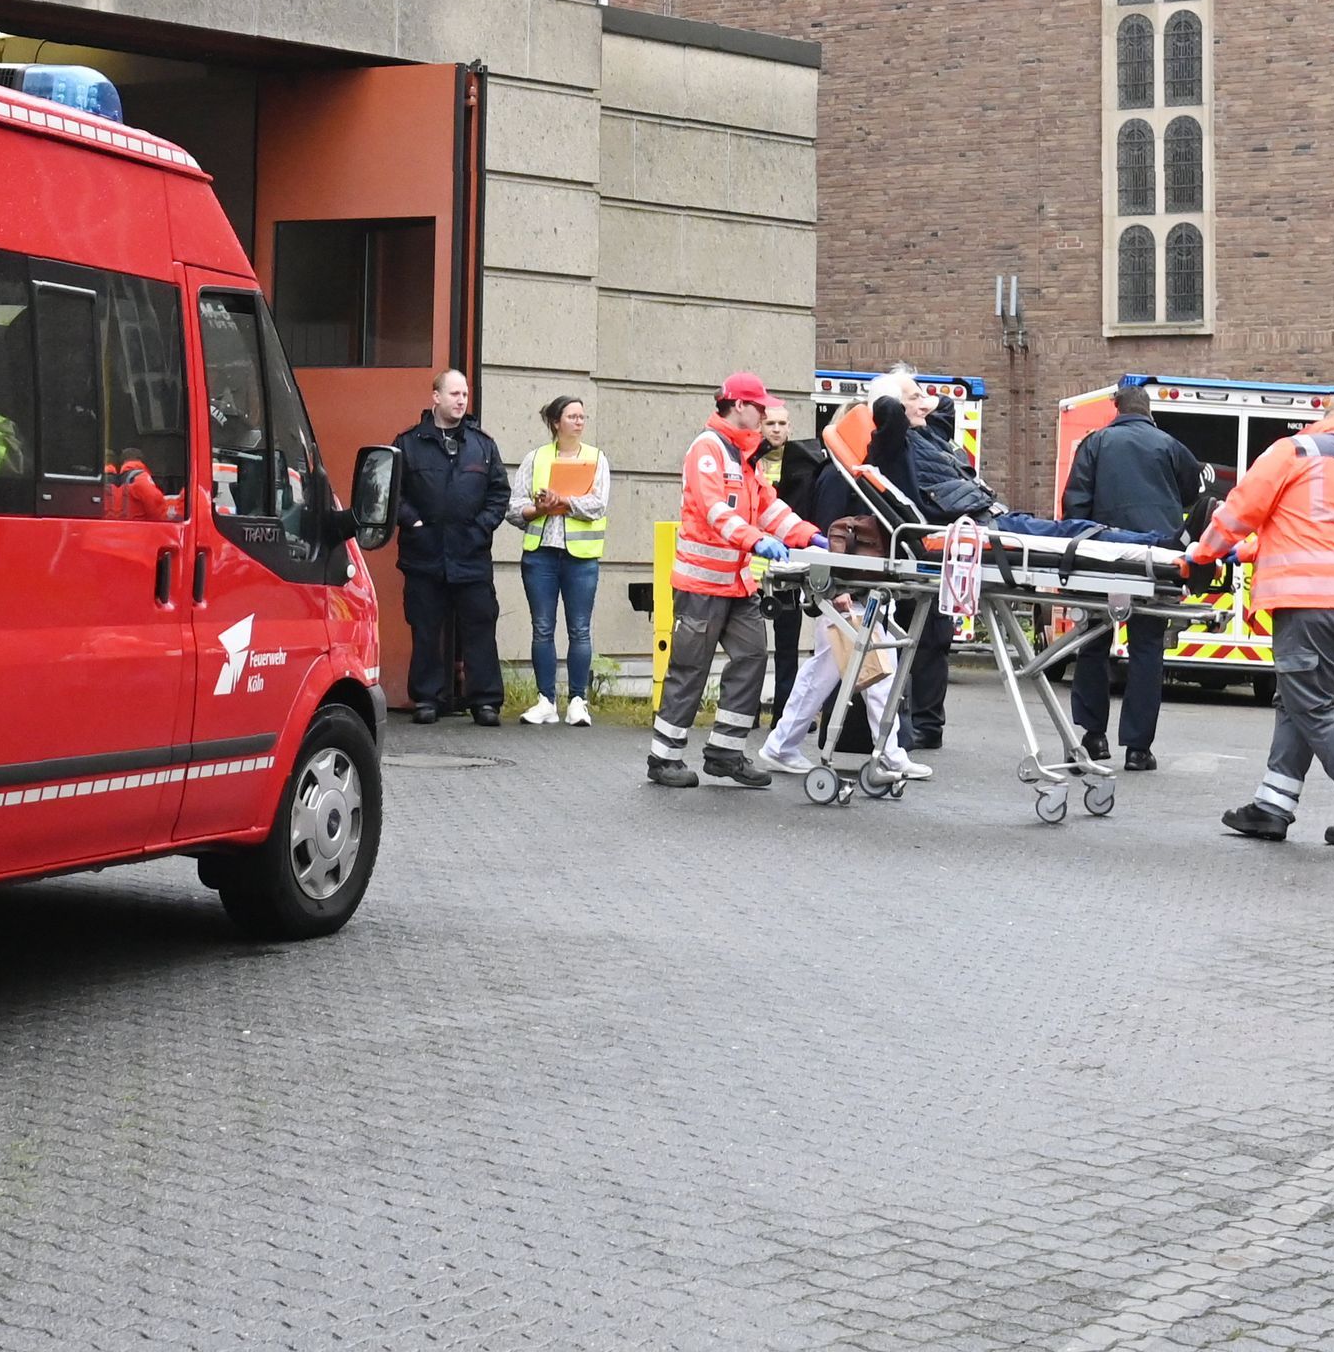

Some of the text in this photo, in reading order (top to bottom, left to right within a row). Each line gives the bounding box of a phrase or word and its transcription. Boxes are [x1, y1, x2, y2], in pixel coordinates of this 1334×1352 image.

[243, 526, 281, 543] TRANSIT
[249, 648, 287, 668] Feuerwehr
[247, 673, 264, 693] Köln
